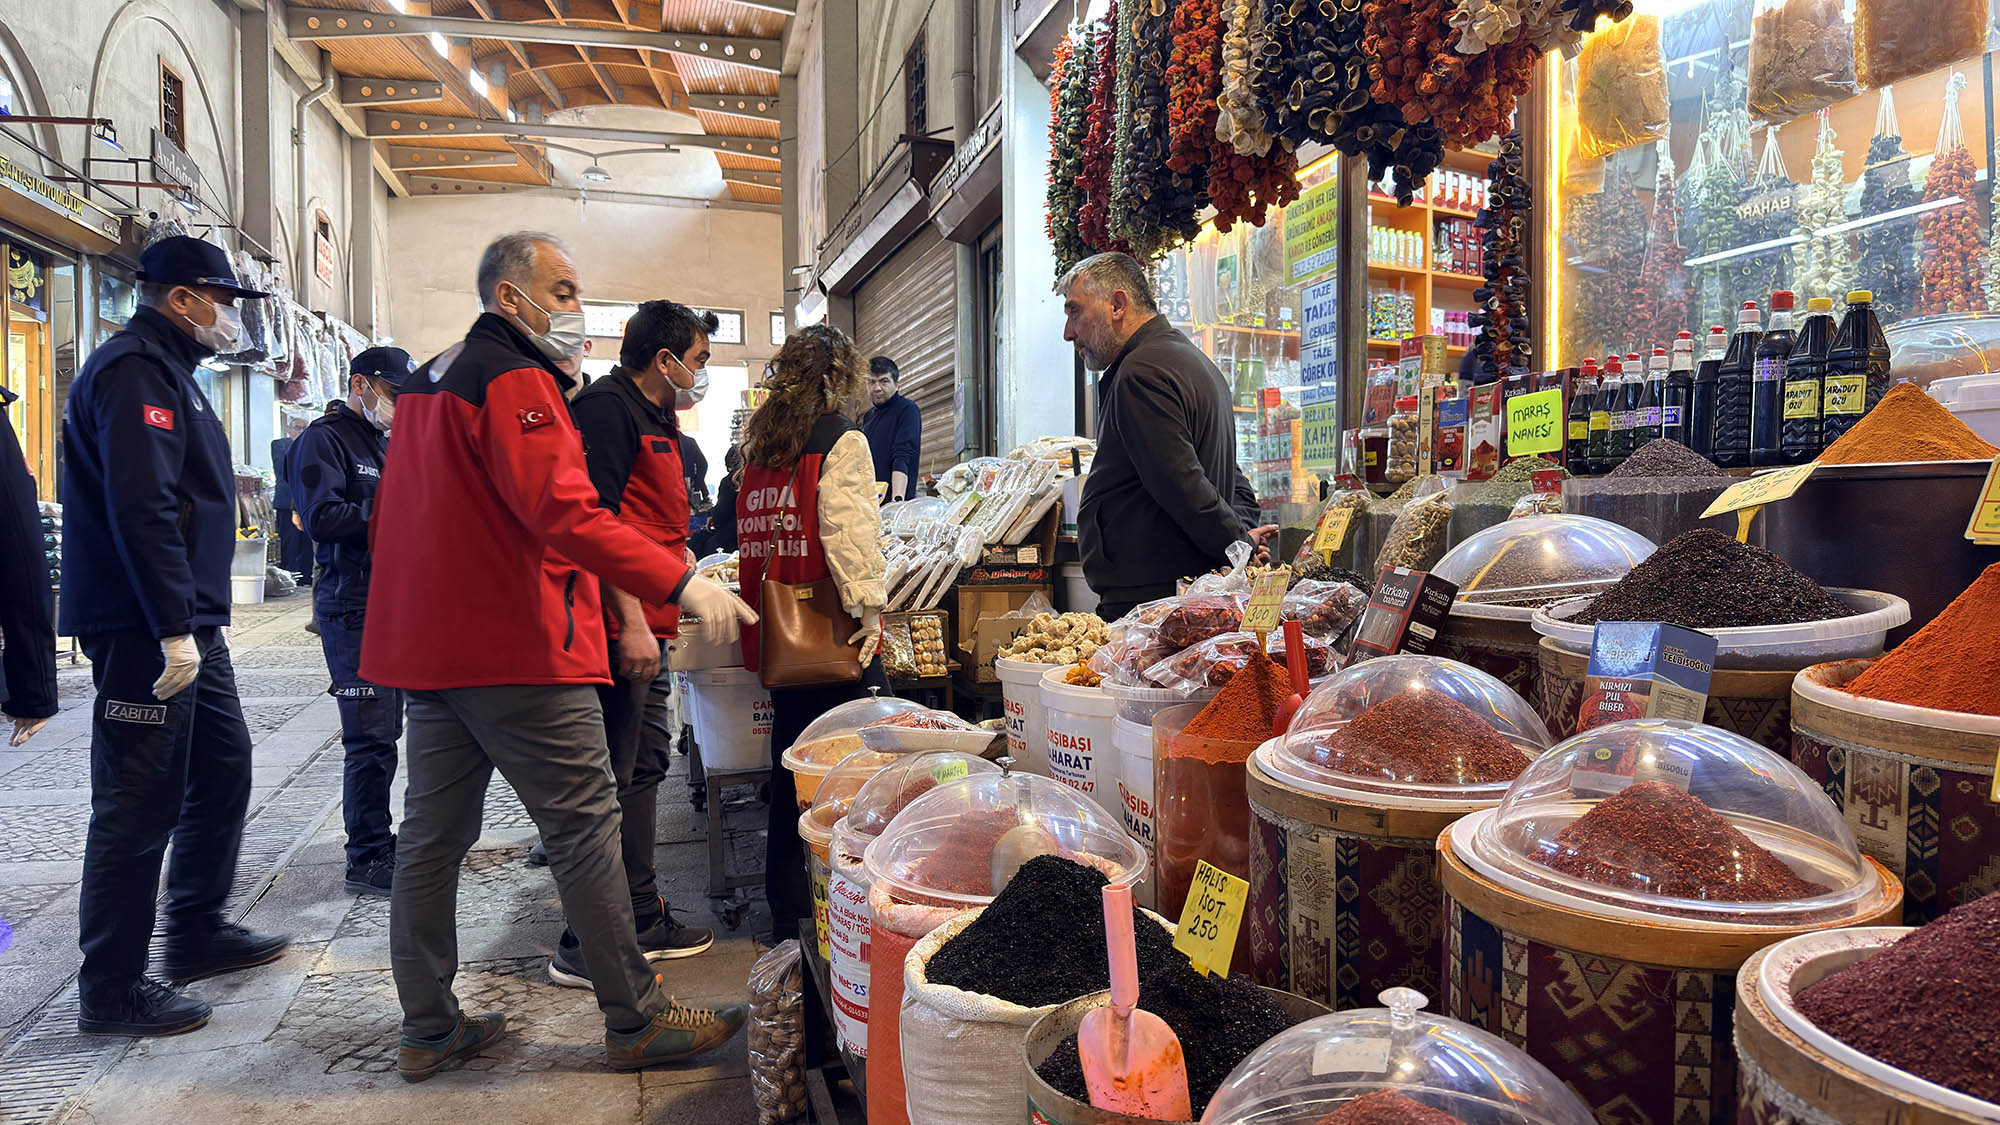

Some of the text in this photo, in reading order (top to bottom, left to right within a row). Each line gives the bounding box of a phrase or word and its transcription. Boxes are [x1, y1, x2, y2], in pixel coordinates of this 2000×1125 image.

[1312, 283, 1332, 300] TAZE
[1312, 345, 1333, 361] TAZE
[1512, 402, 1551, 424] MARAŞ
[1512, 420, 1555, 443] NANESİ
[746, 485, 797, 512] GIDA
[737, 513, 803, 534] KONTOL
[1379, 583, 1410, 600] Kırkaltı
[1424, 586, 1451, 602] Kırkaltı
[1382, 595, 1406, 607] baharat
[334, 687, 375, 697] ZABITA
[1599, 680, 1632, 693] KIRMIZI
[1605, 691, 1622, 702] PUL
[109, 704, 160, 721] ZABITA
[1598, 700, 1624, 713] BİBER
[1082, 781, 1095, 792] 47
[1196, 863, 1228, 893] HALİS
[1199, 885, 1226, 919] İSOT
[1188, 914, 1218, 941] 250
[852, 983, 867, 997] 25
